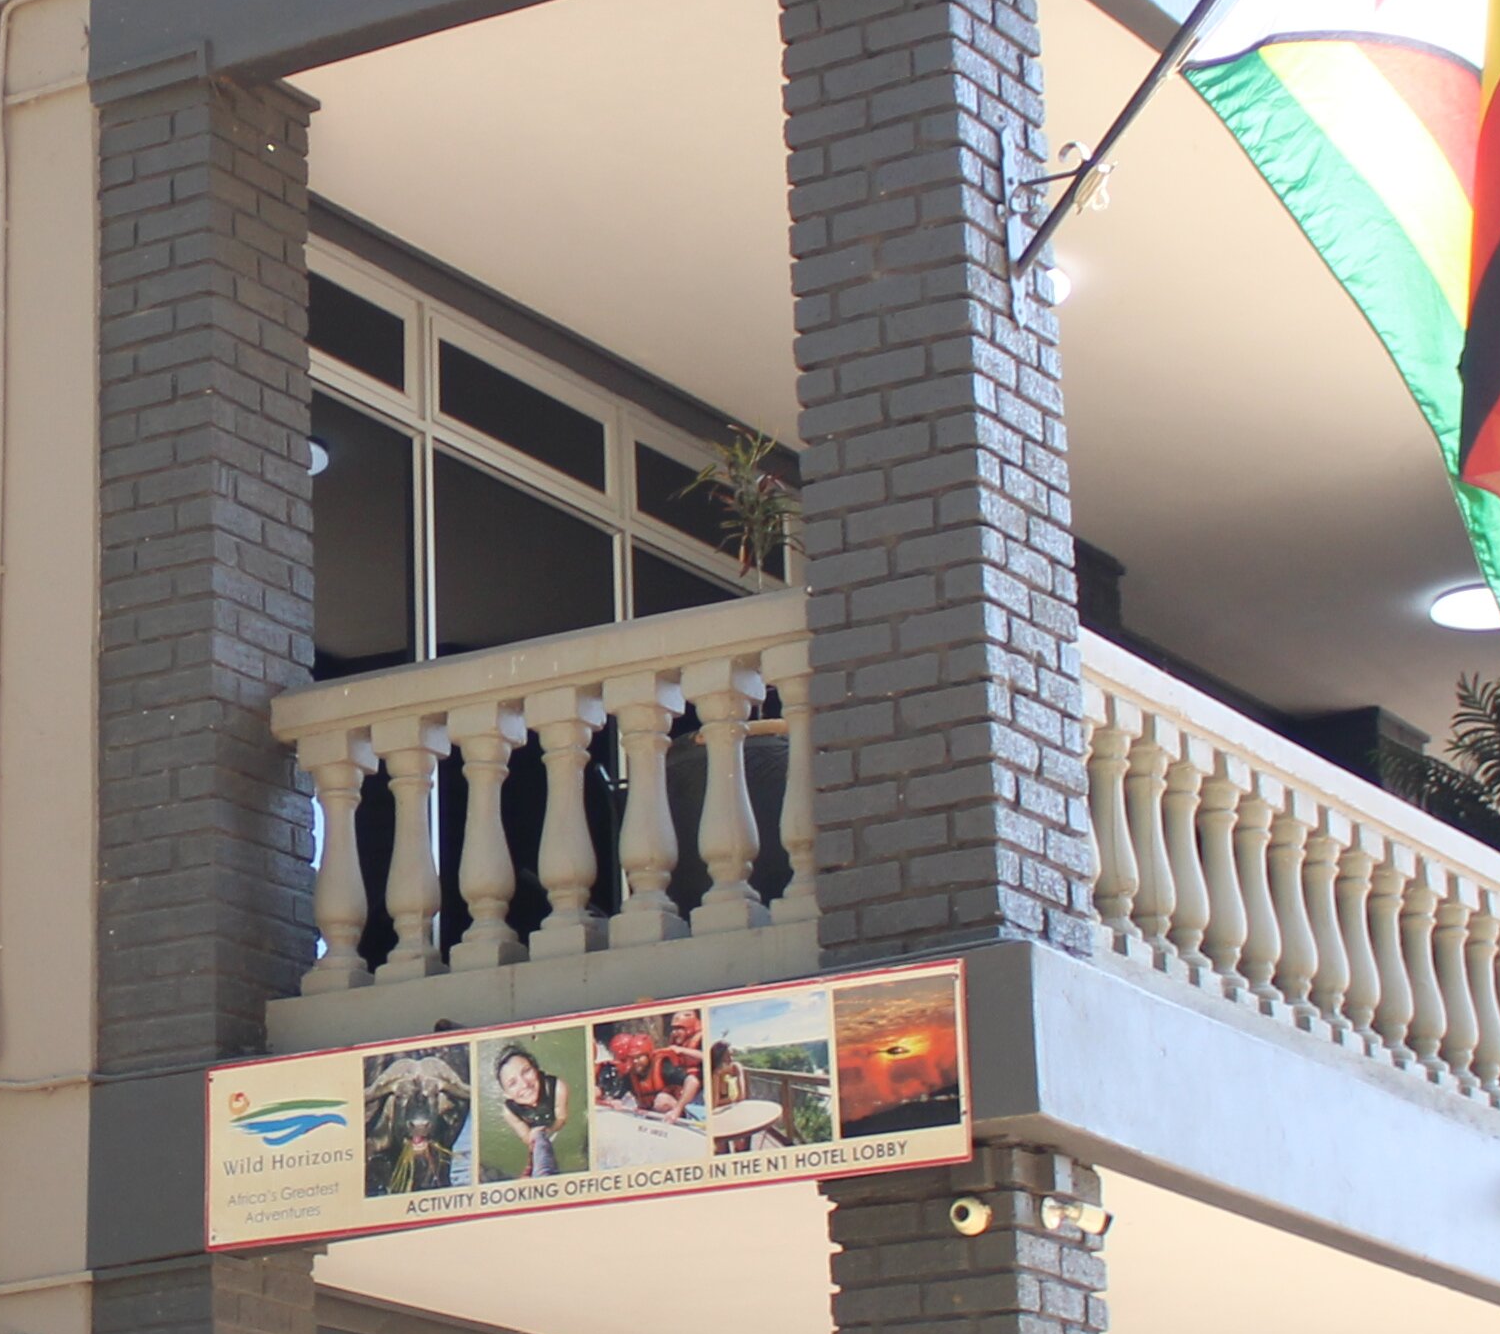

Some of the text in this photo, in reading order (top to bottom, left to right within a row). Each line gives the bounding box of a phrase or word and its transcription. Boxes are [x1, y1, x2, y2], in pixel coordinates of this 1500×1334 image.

[222, 1145, 354, 1177] Wild Horizons
[406, 1140, 908, 1216] ACTIVITY BOOKING OFFICE LOCATED IN THE N1 HOTEL LOBBY
[227, 1180, 340, 1208] Africa's Greatest
[244, 1201, 322, 1226] Adventures
